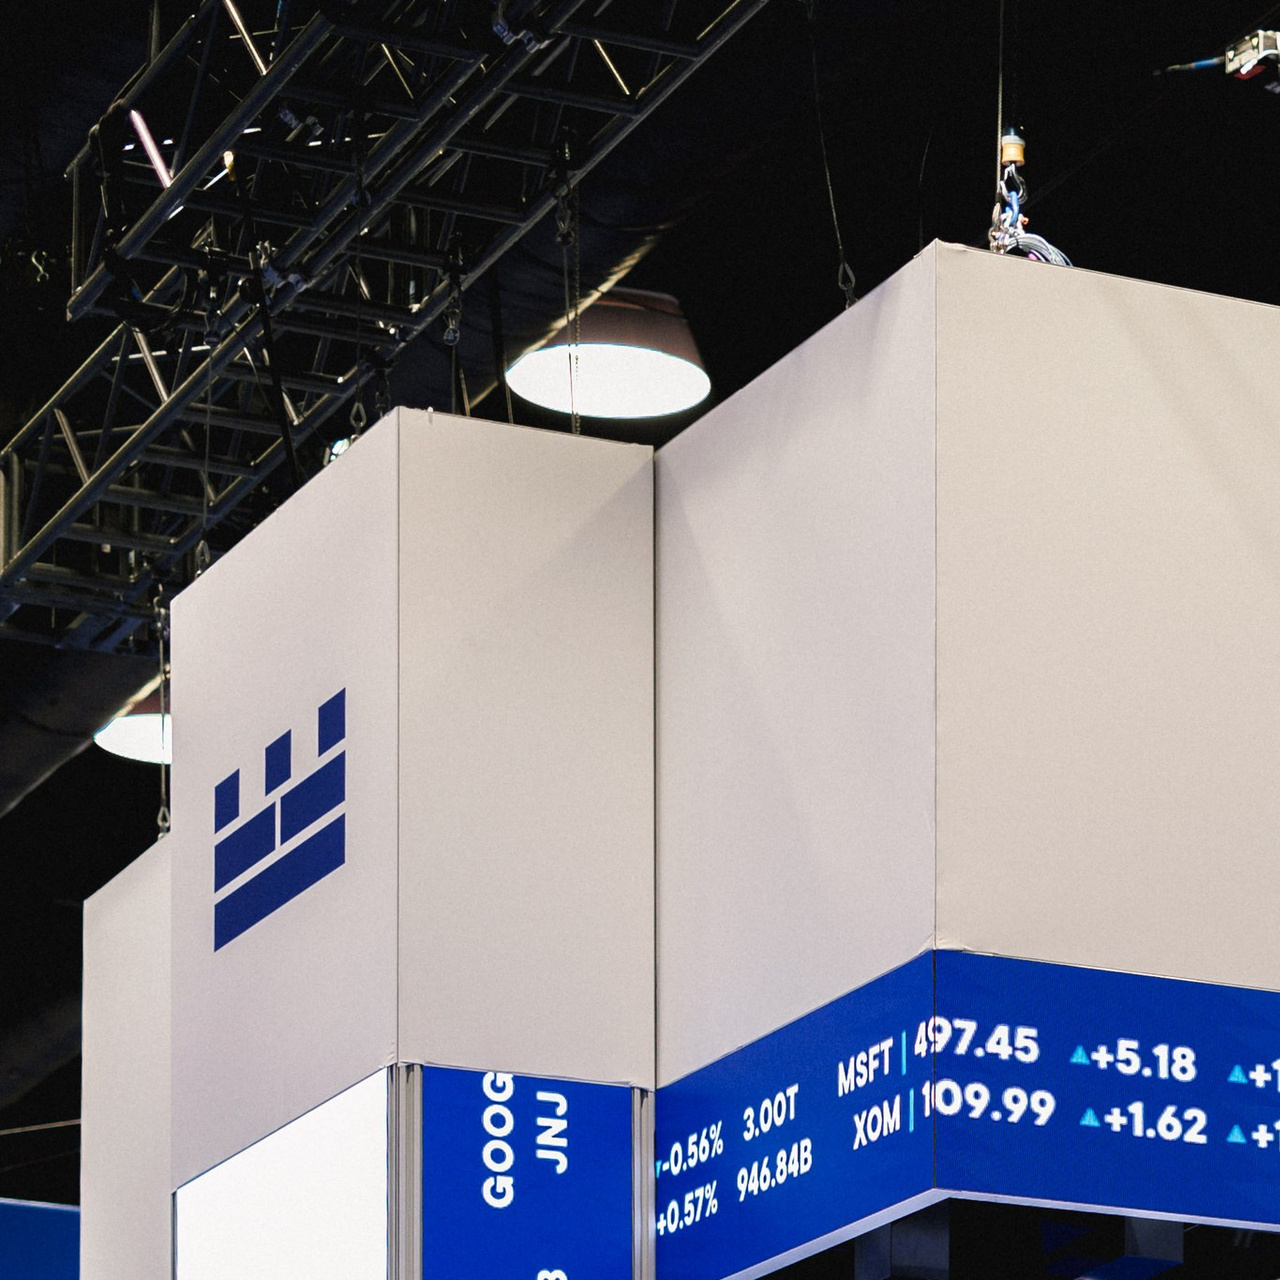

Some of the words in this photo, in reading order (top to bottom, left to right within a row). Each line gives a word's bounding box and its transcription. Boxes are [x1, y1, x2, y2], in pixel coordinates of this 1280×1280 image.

[537, 1092, 567, 1173] JNJ
[657, 1181, 717, 1235] +0.57%
[737, 1138, 813, 1202] 946.84B
[852, 1094, 901, 1150] XOM
[922, 1080, 1055, 1125] 109.99
[1105, 1102, 1206, 1143] +1.62
[662, 1121, 724, 1178] -0.56%
[743, 1083, 799, 1141] 3.00T
[837, 1038, 894, 1097] MSFT
[915, 1017, 1039, 1062] 497.45
[1091, 1039, 1196, 1081] +5.18
